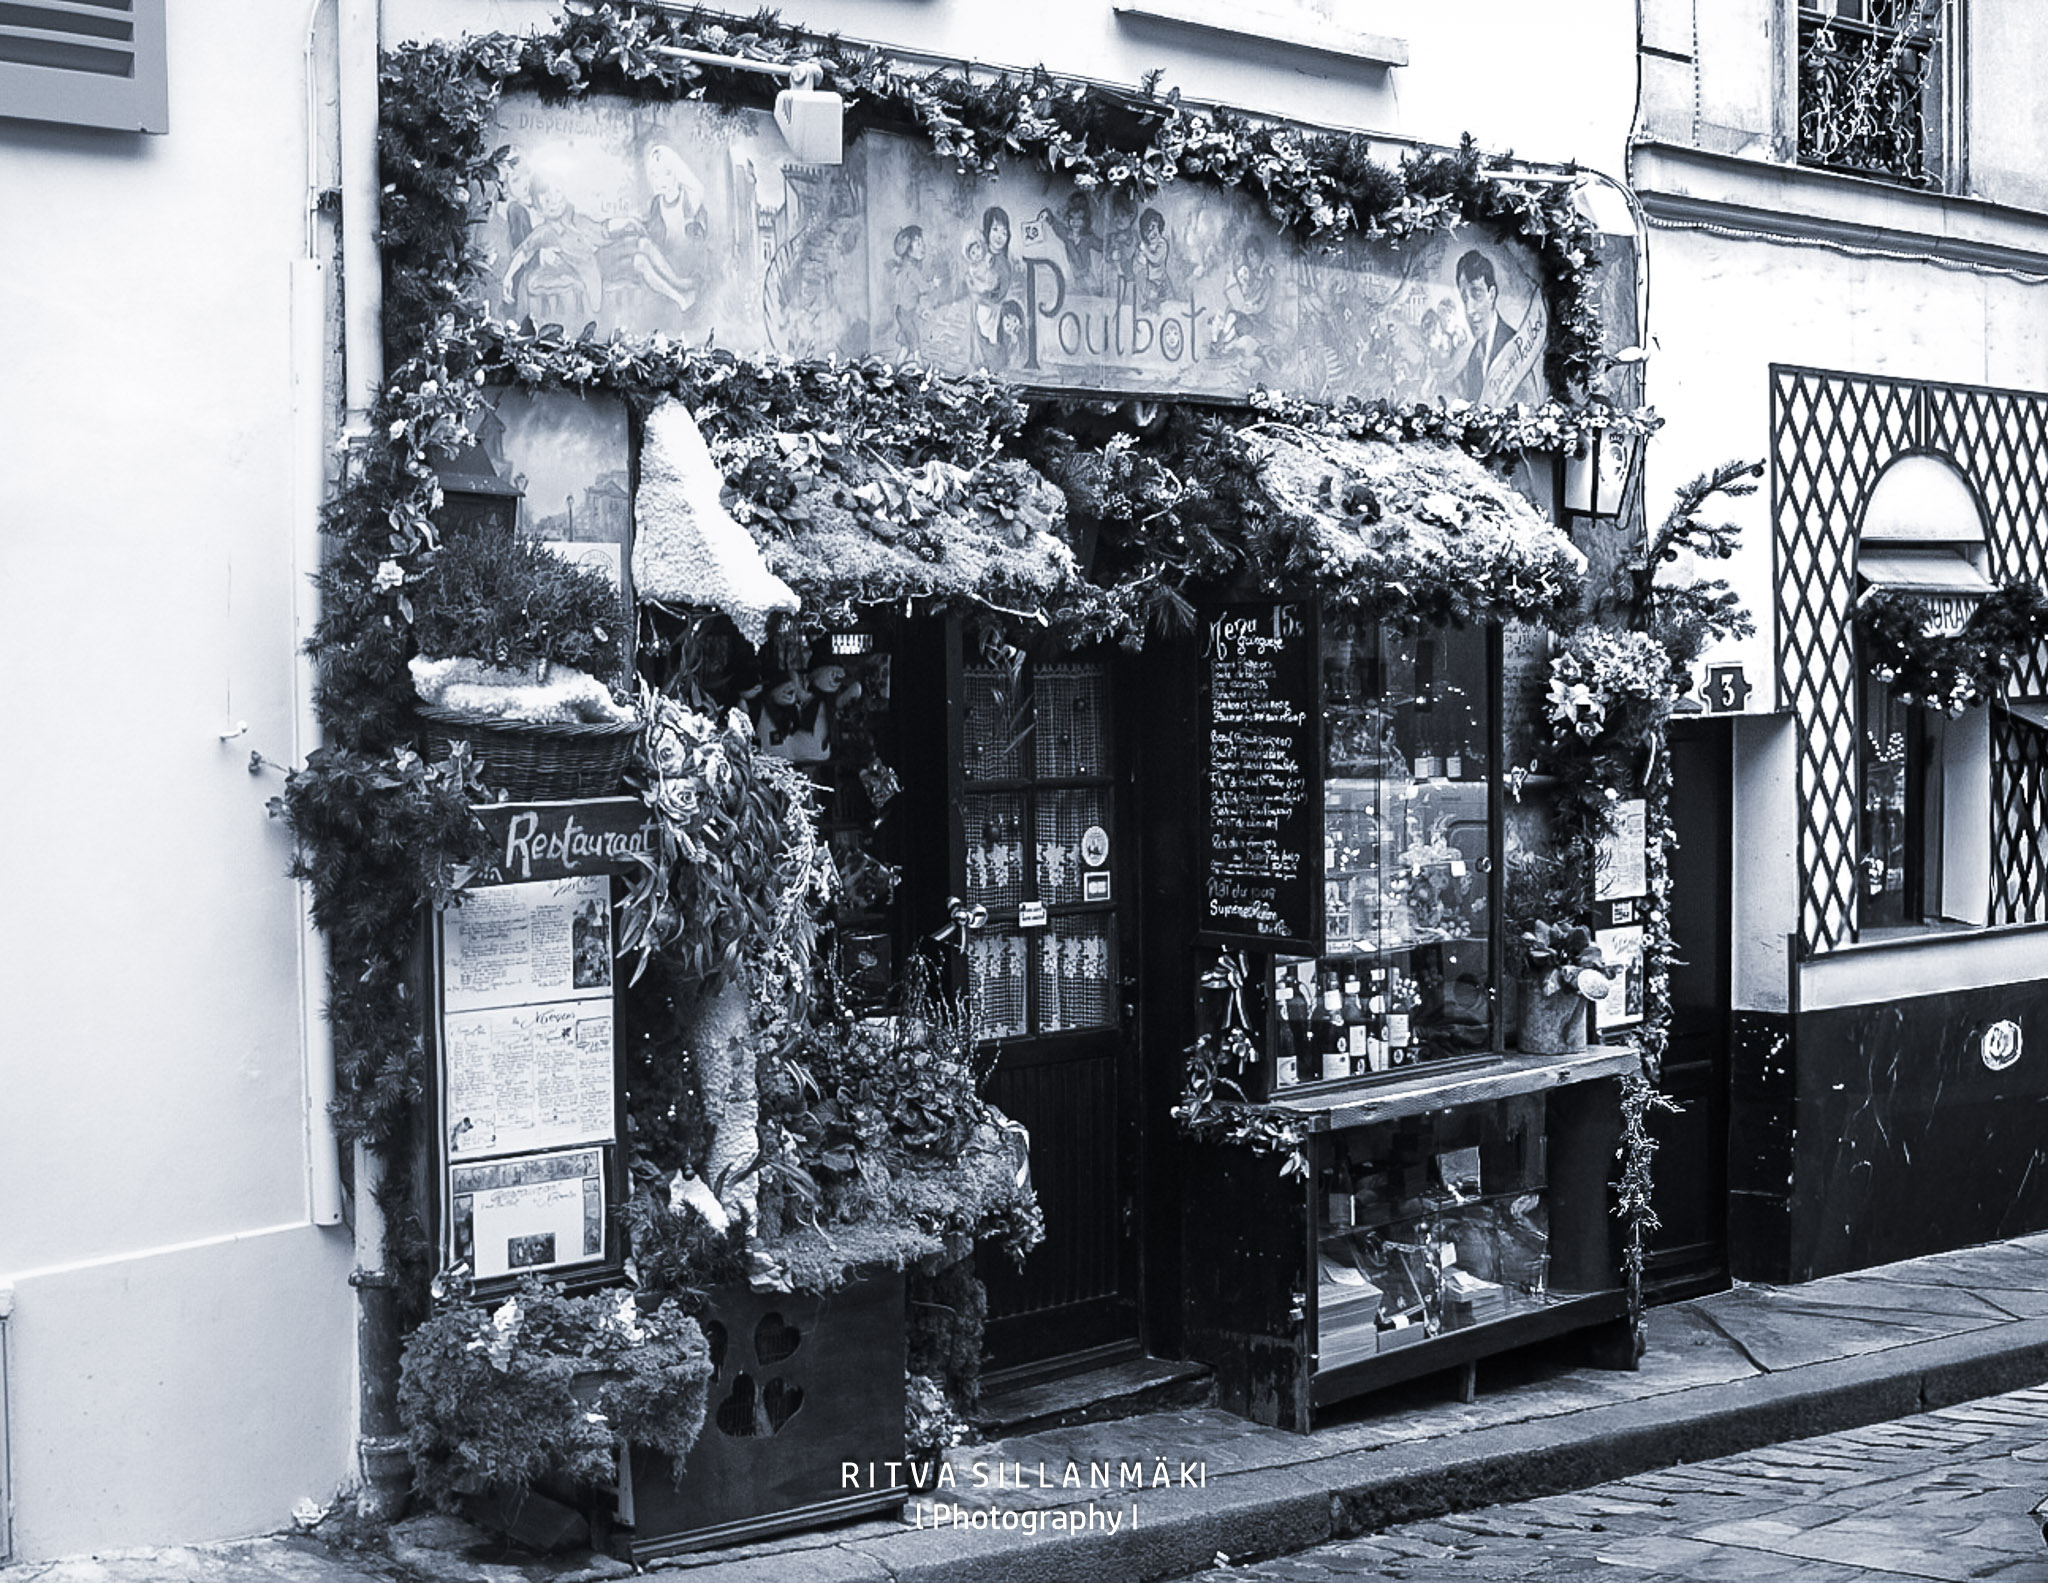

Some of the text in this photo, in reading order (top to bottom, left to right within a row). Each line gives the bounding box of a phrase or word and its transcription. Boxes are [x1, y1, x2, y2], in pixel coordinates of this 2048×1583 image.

[1022, 256, 1206, 370] Poulbot
[1721, 673, 1735, 707] 3
[506, 811, 659, 878] Restaurant
